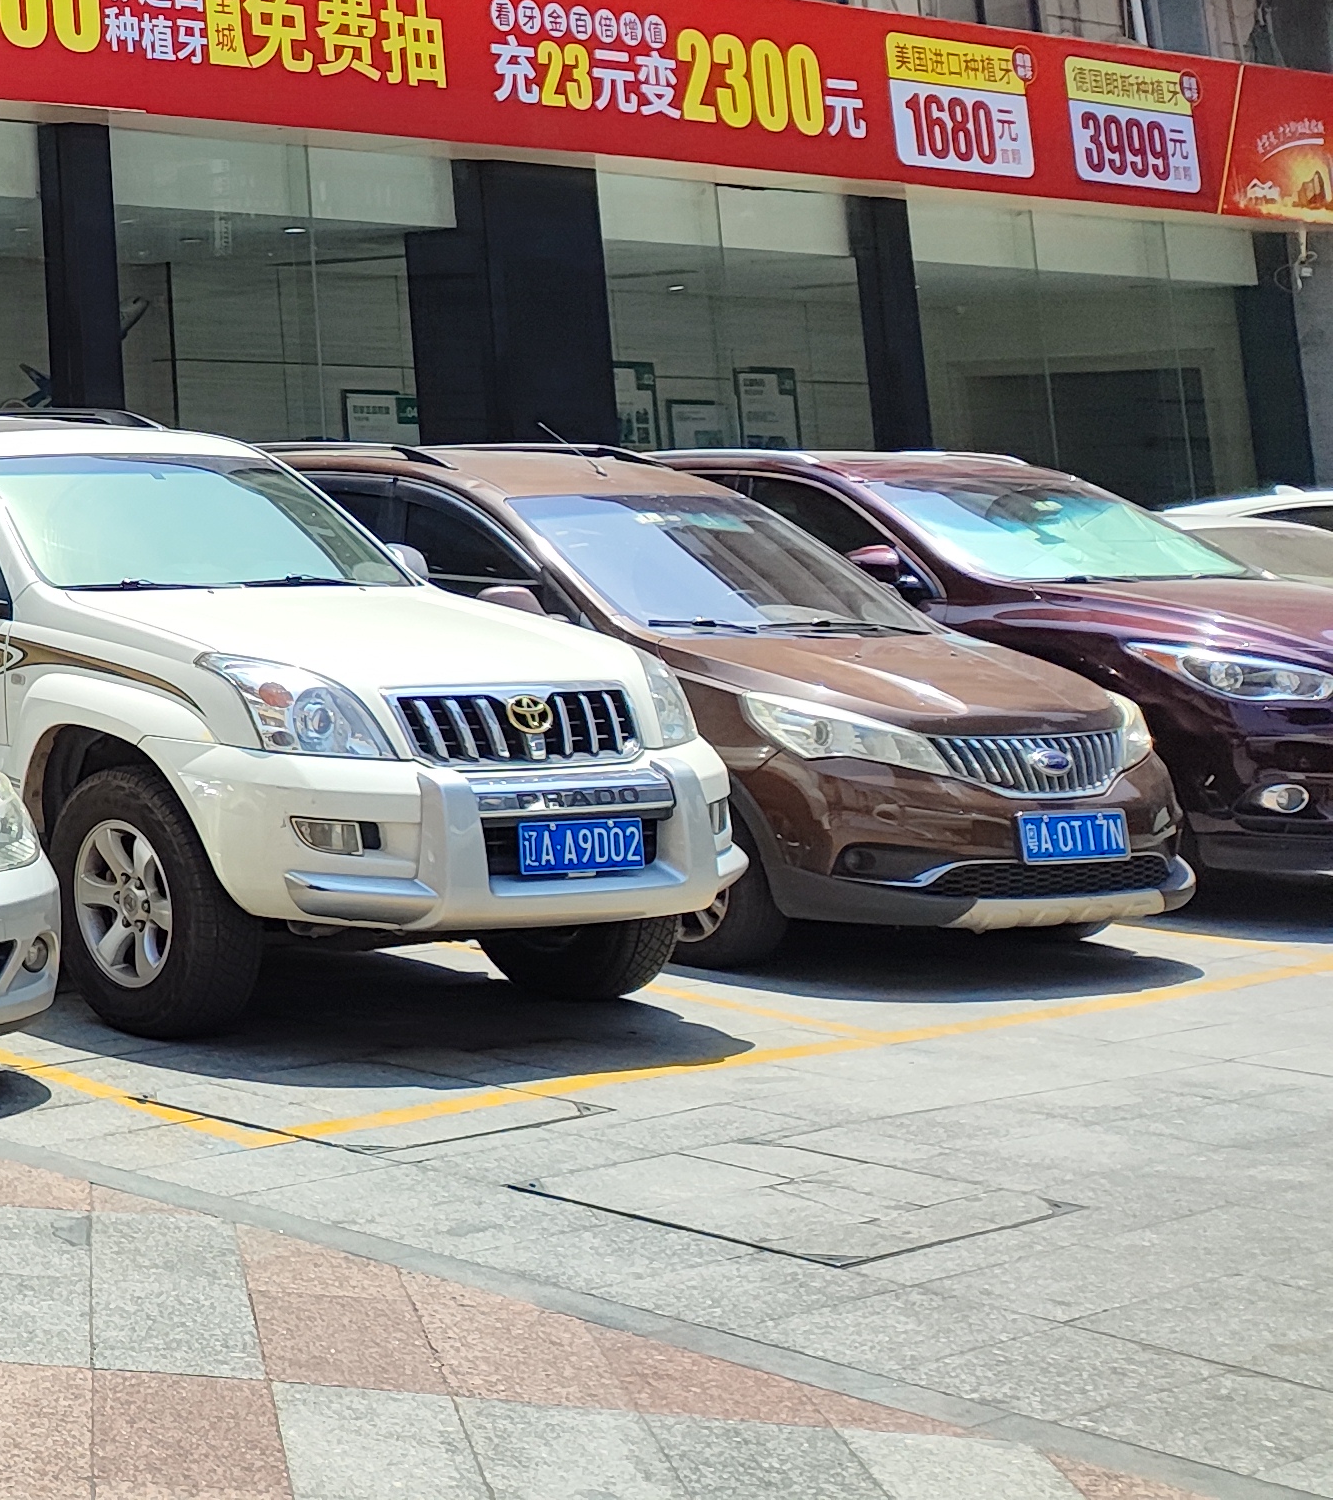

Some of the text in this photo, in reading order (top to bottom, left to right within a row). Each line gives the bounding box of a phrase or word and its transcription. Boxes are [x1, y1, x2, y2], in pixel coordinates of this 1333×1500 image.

[103, 5, 208, 64] 种植牙
[494, 1, 666, 46] 看牙金百倍增值
[895, 41, 1013, 85] 美国进口种植牙
[1072, 65, 1180, 106] 德国朗斯种植牙
[516, 787, 640, 810] PRADO
